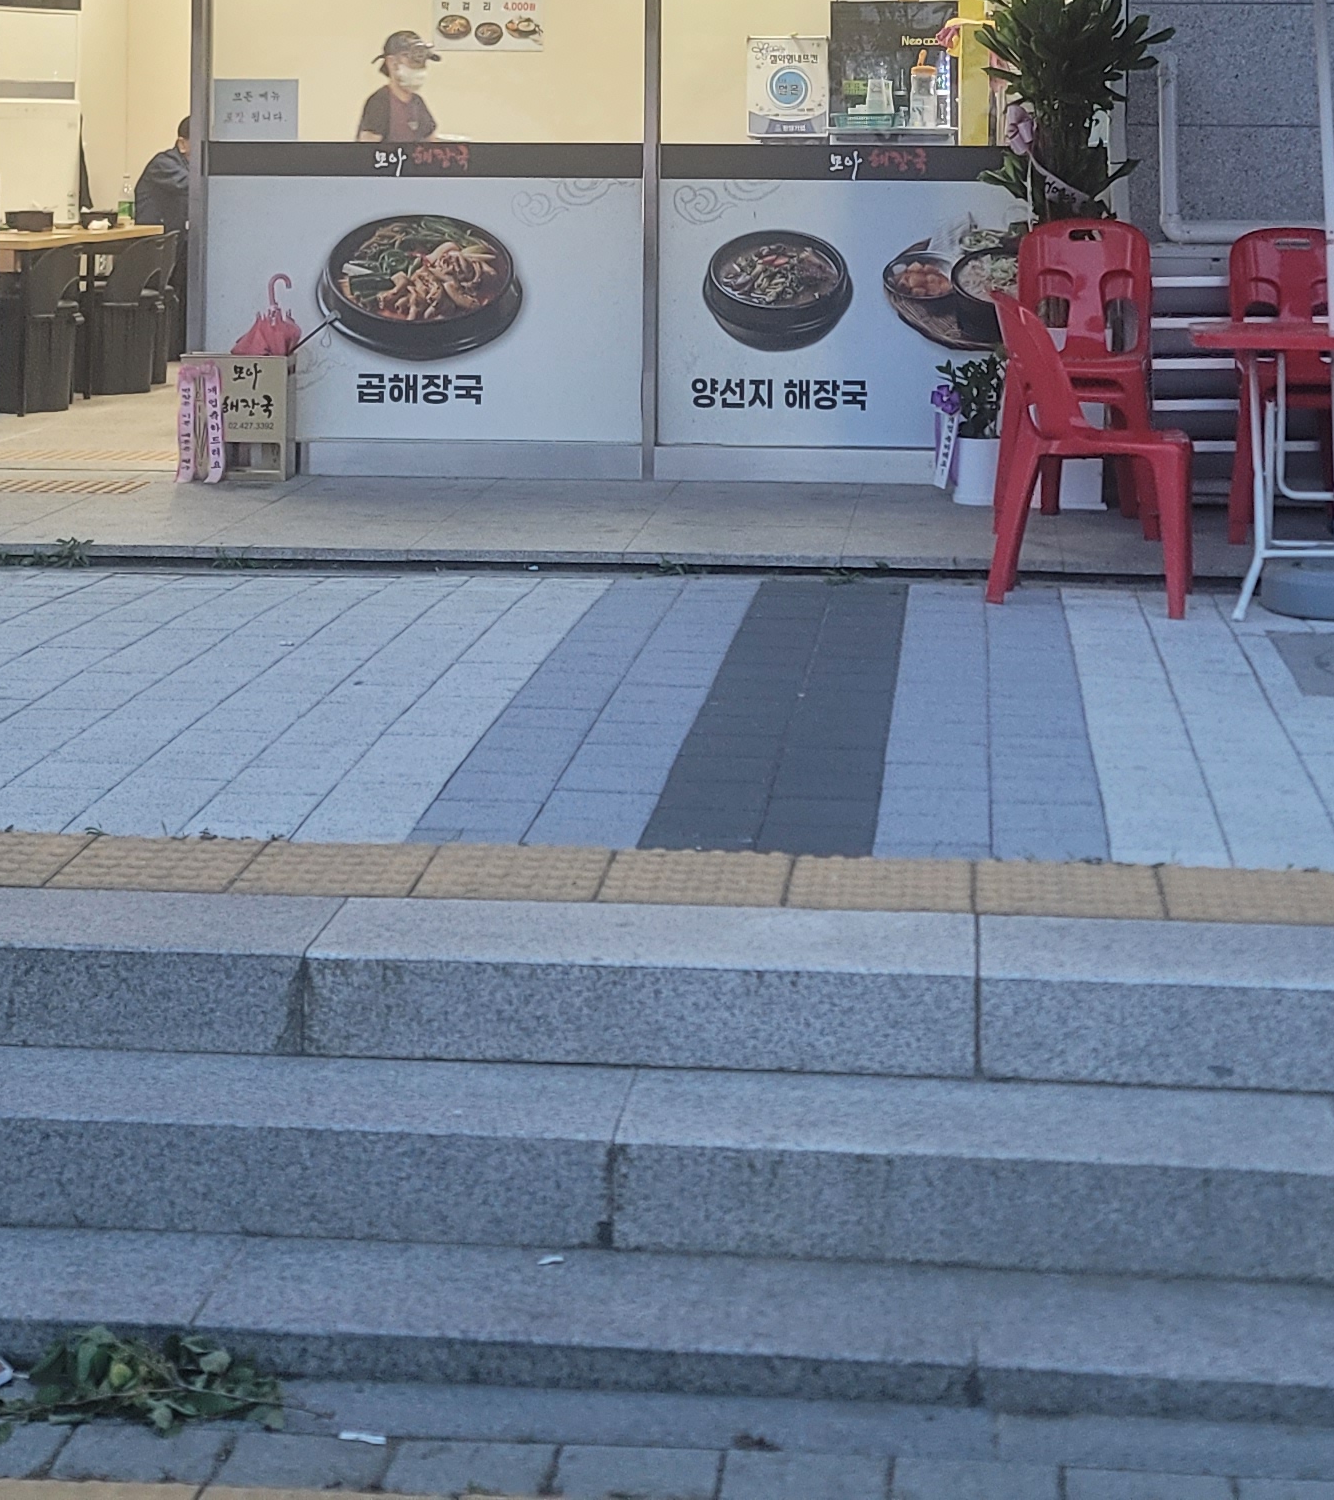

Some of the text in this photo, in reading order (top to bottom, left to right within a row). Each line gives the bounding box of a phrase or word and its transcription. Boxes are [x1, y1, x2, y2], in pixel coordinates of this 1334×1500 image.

[374, 143, 468, 177] 모아 해장국
[829, 148, 927, 180] 모아 해장국
[233, 363, 262, 390] 모아
[356, 373, 484, 405] 곱해장국
[222, 394, 274, 419] 해장국
[691, 378, 868, 411] 양선지 해장국
